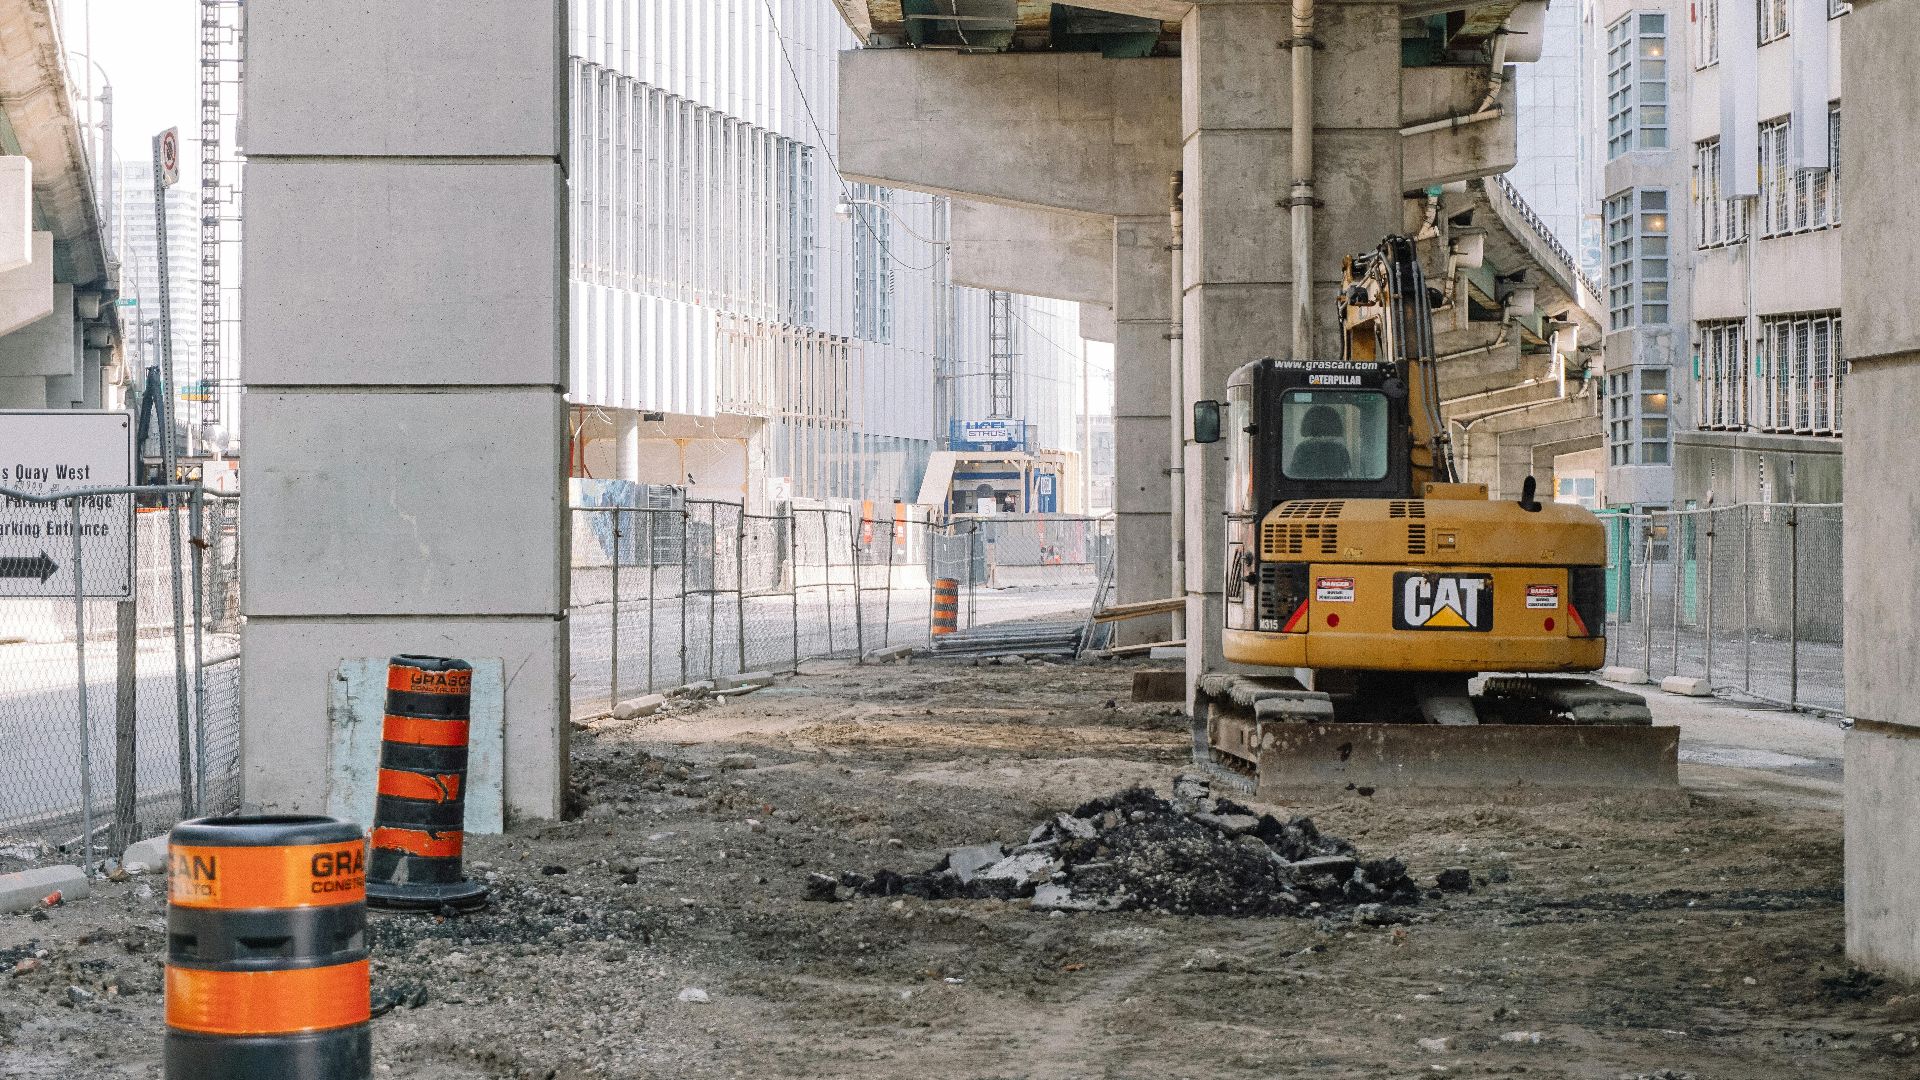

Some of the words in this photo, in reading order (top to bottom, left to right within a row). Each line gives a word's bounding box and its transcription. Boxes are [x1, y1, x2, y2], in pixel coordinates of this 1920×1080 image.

[1274, 360, 1378, 371] www.grascan.com
[1308, 374, 1362, 385] CATERPILLAR
[15, 463, 49, 482] Quay
[55, 464, 90, 480] West
[1404, 576, 1485, 628] CAT
